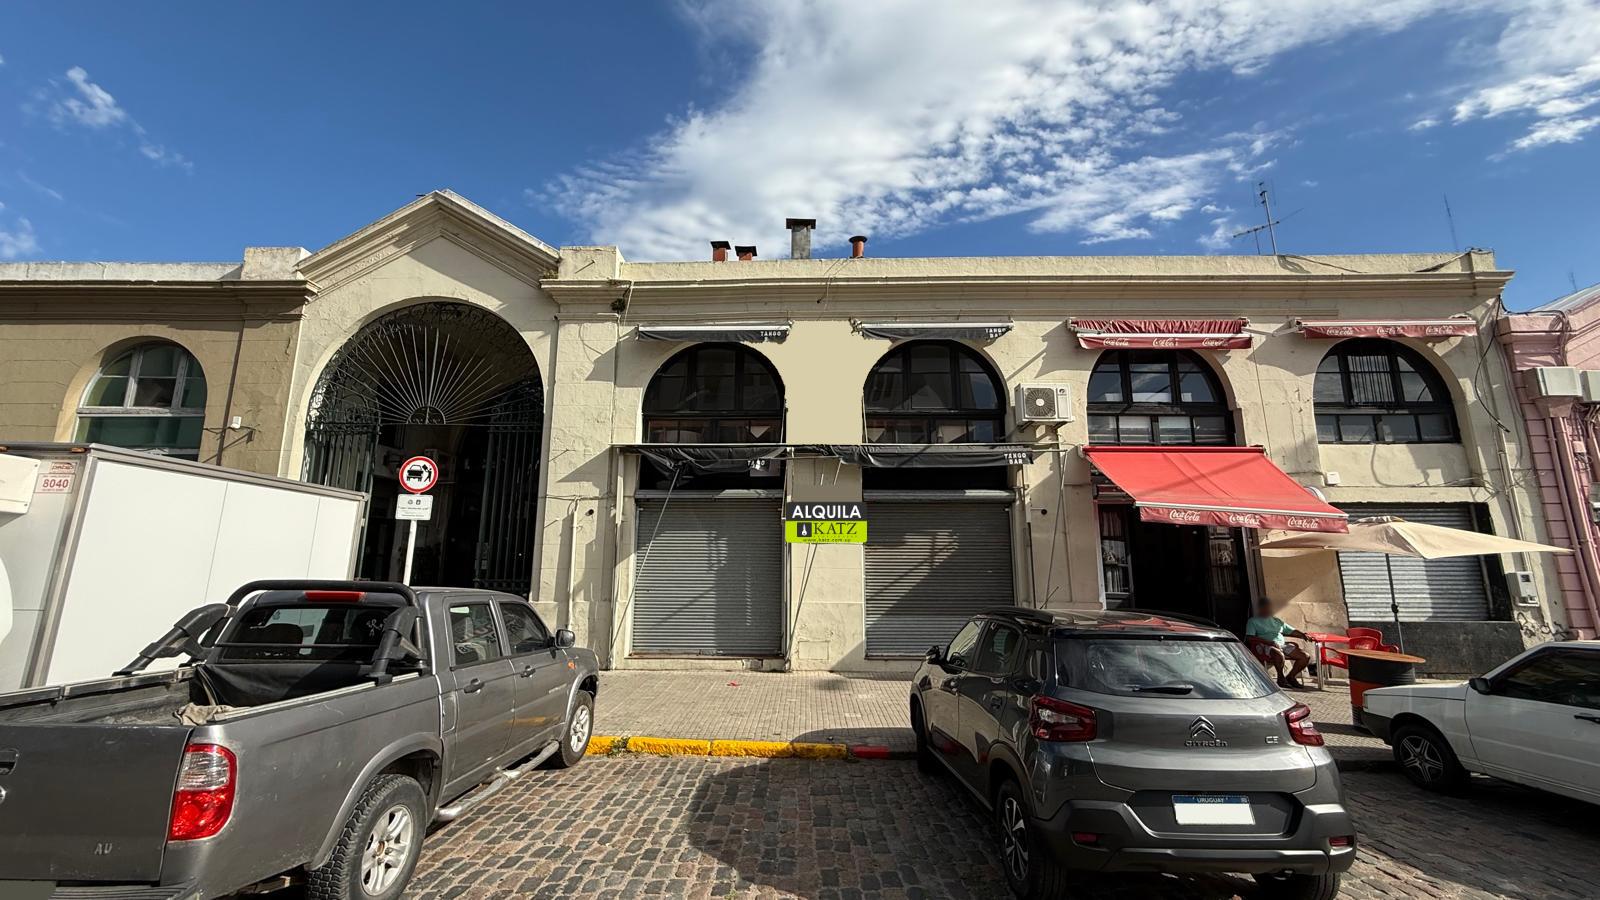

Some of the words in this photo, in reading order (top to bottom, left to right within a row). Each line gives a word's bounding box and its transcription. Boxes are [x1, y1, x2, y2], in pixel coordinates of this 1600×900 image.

[43, 479, 69, 488] 8040
[792, 504, 862, 520] ALQUILA
[813, 522, 857, 535] KATZ
